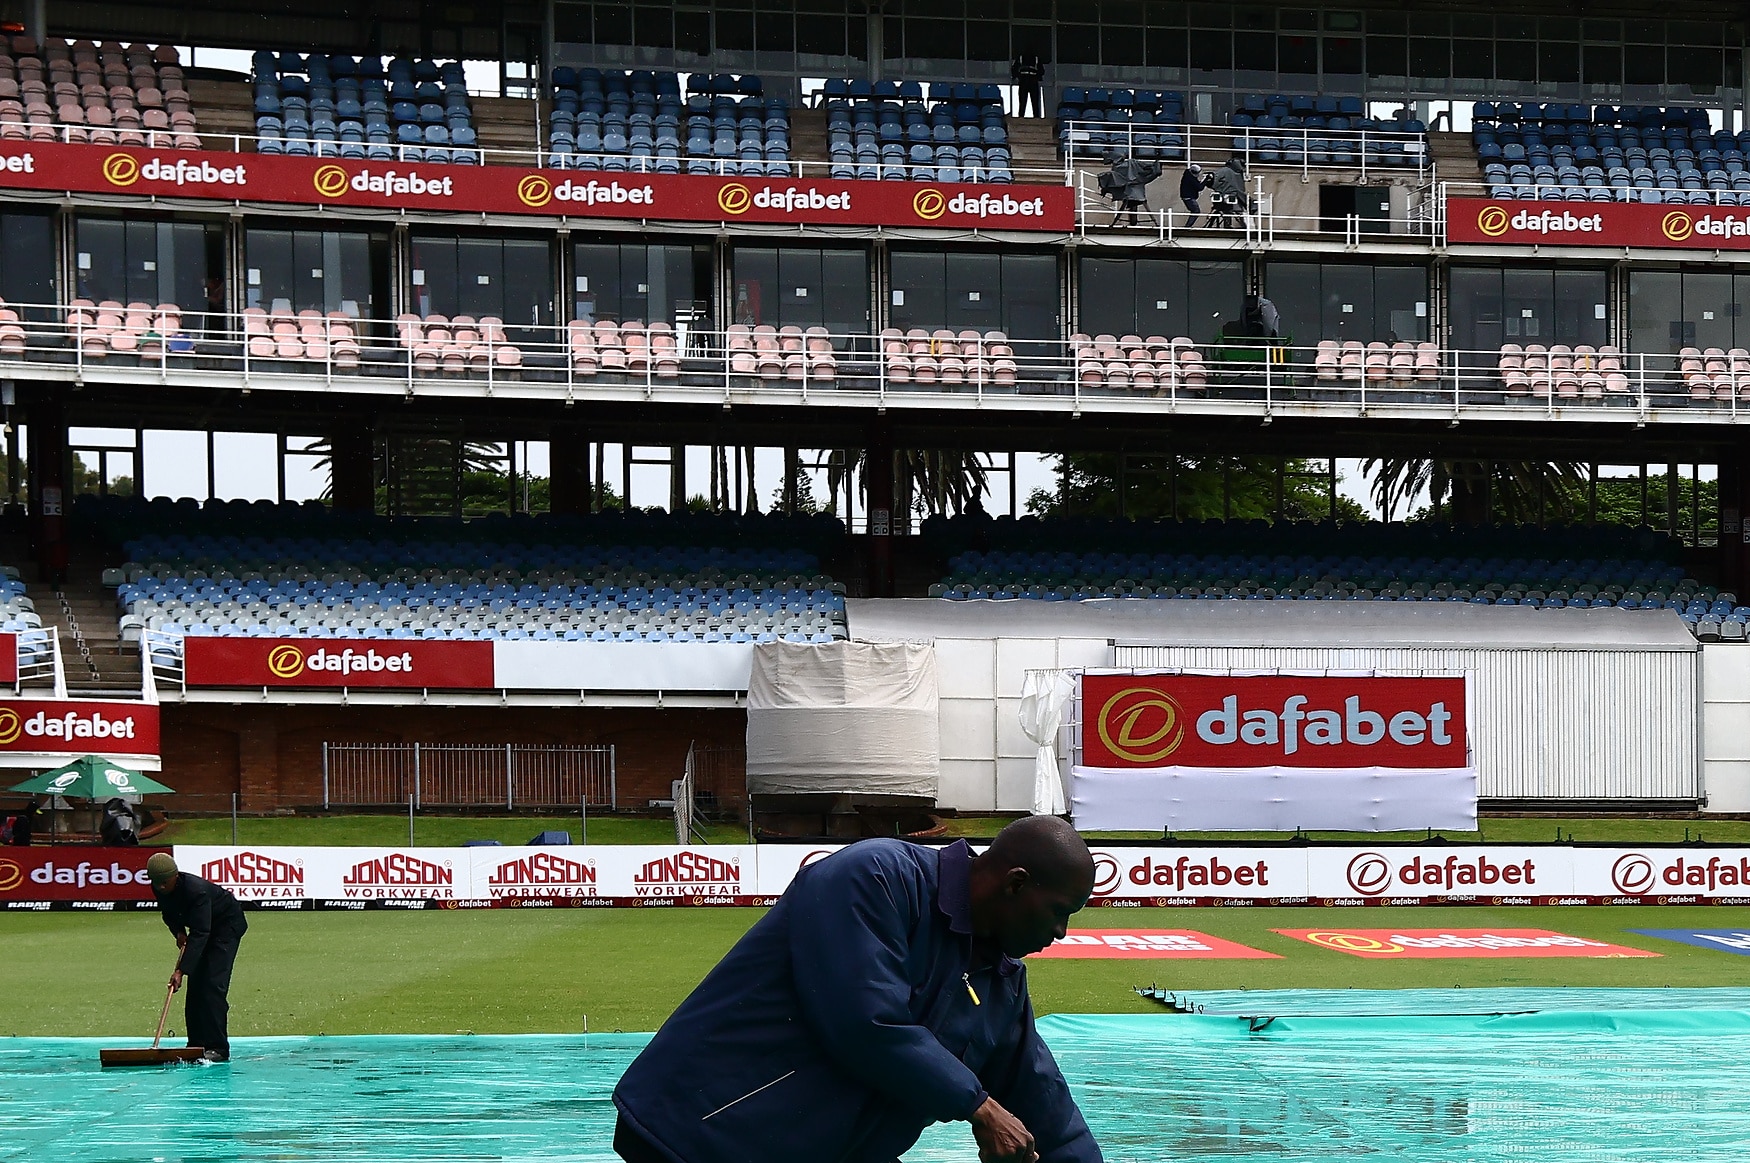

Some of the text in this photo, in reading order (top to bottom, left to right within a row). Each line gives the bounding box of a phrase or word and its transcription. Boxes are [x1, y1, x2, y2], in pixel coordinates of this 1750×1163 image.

[142, 158, 246, 185] dafabet
[352, 170, 452, 196] dafabet
[555, 180, 653, 205] dafabet
[754, 187, 850, 212] dafabet
[949, 193, 1043, 217] dafabet
[1512, 210, 1601, 234] dafabet
[308, 649, 412, 675] dafabet
[25, 712, 134, 741] dafabet
[1197, 695, 1451, 754] dafabet
[344, 854, 452, 883] JONSSON
[489, 853, 595, 883] JONSSON
[635, 852, 740, 882] JONSSON
[31, 862, 151, 887] dafabe
[1129, 857, 1268, 891] dafabet
[1399, 856, 1535, 890] dafabet
[227, 888, 304, 896] RKWEAR
[344, 889, 452, 898] WORKWEAR
[490, 888, 597, 898] WORKWEAR
[635, 886, 740, 895] WORKWEAR
[458, 899, 491, 908] dafabet
[521, 898, 553, 907] dafabet
[582, 898, 613, 907] dafabet
[642, 898, 674, 906] dafabet
[702, 896, 734, 904] dafabet
[1112, 898, 1141, 908] dafabet
[1167, 897, 1196, 906] dafabet
[1280, 896, 1308, 904] dafabet
[1334, 898, 1364, 906] dafabet
[1391, 897, 1420, 906] dafabet
[1502, 896, 1531, 906] dafabet
[1559, 897, 1587, 906] dafabet
[1612, 896, 1640, 905] dafabet
[1668, 895, 1696, 904] dafabet
[1722, 897, 1750, 905] dafabet
[1390, 934, 1609, 949] dafabet
